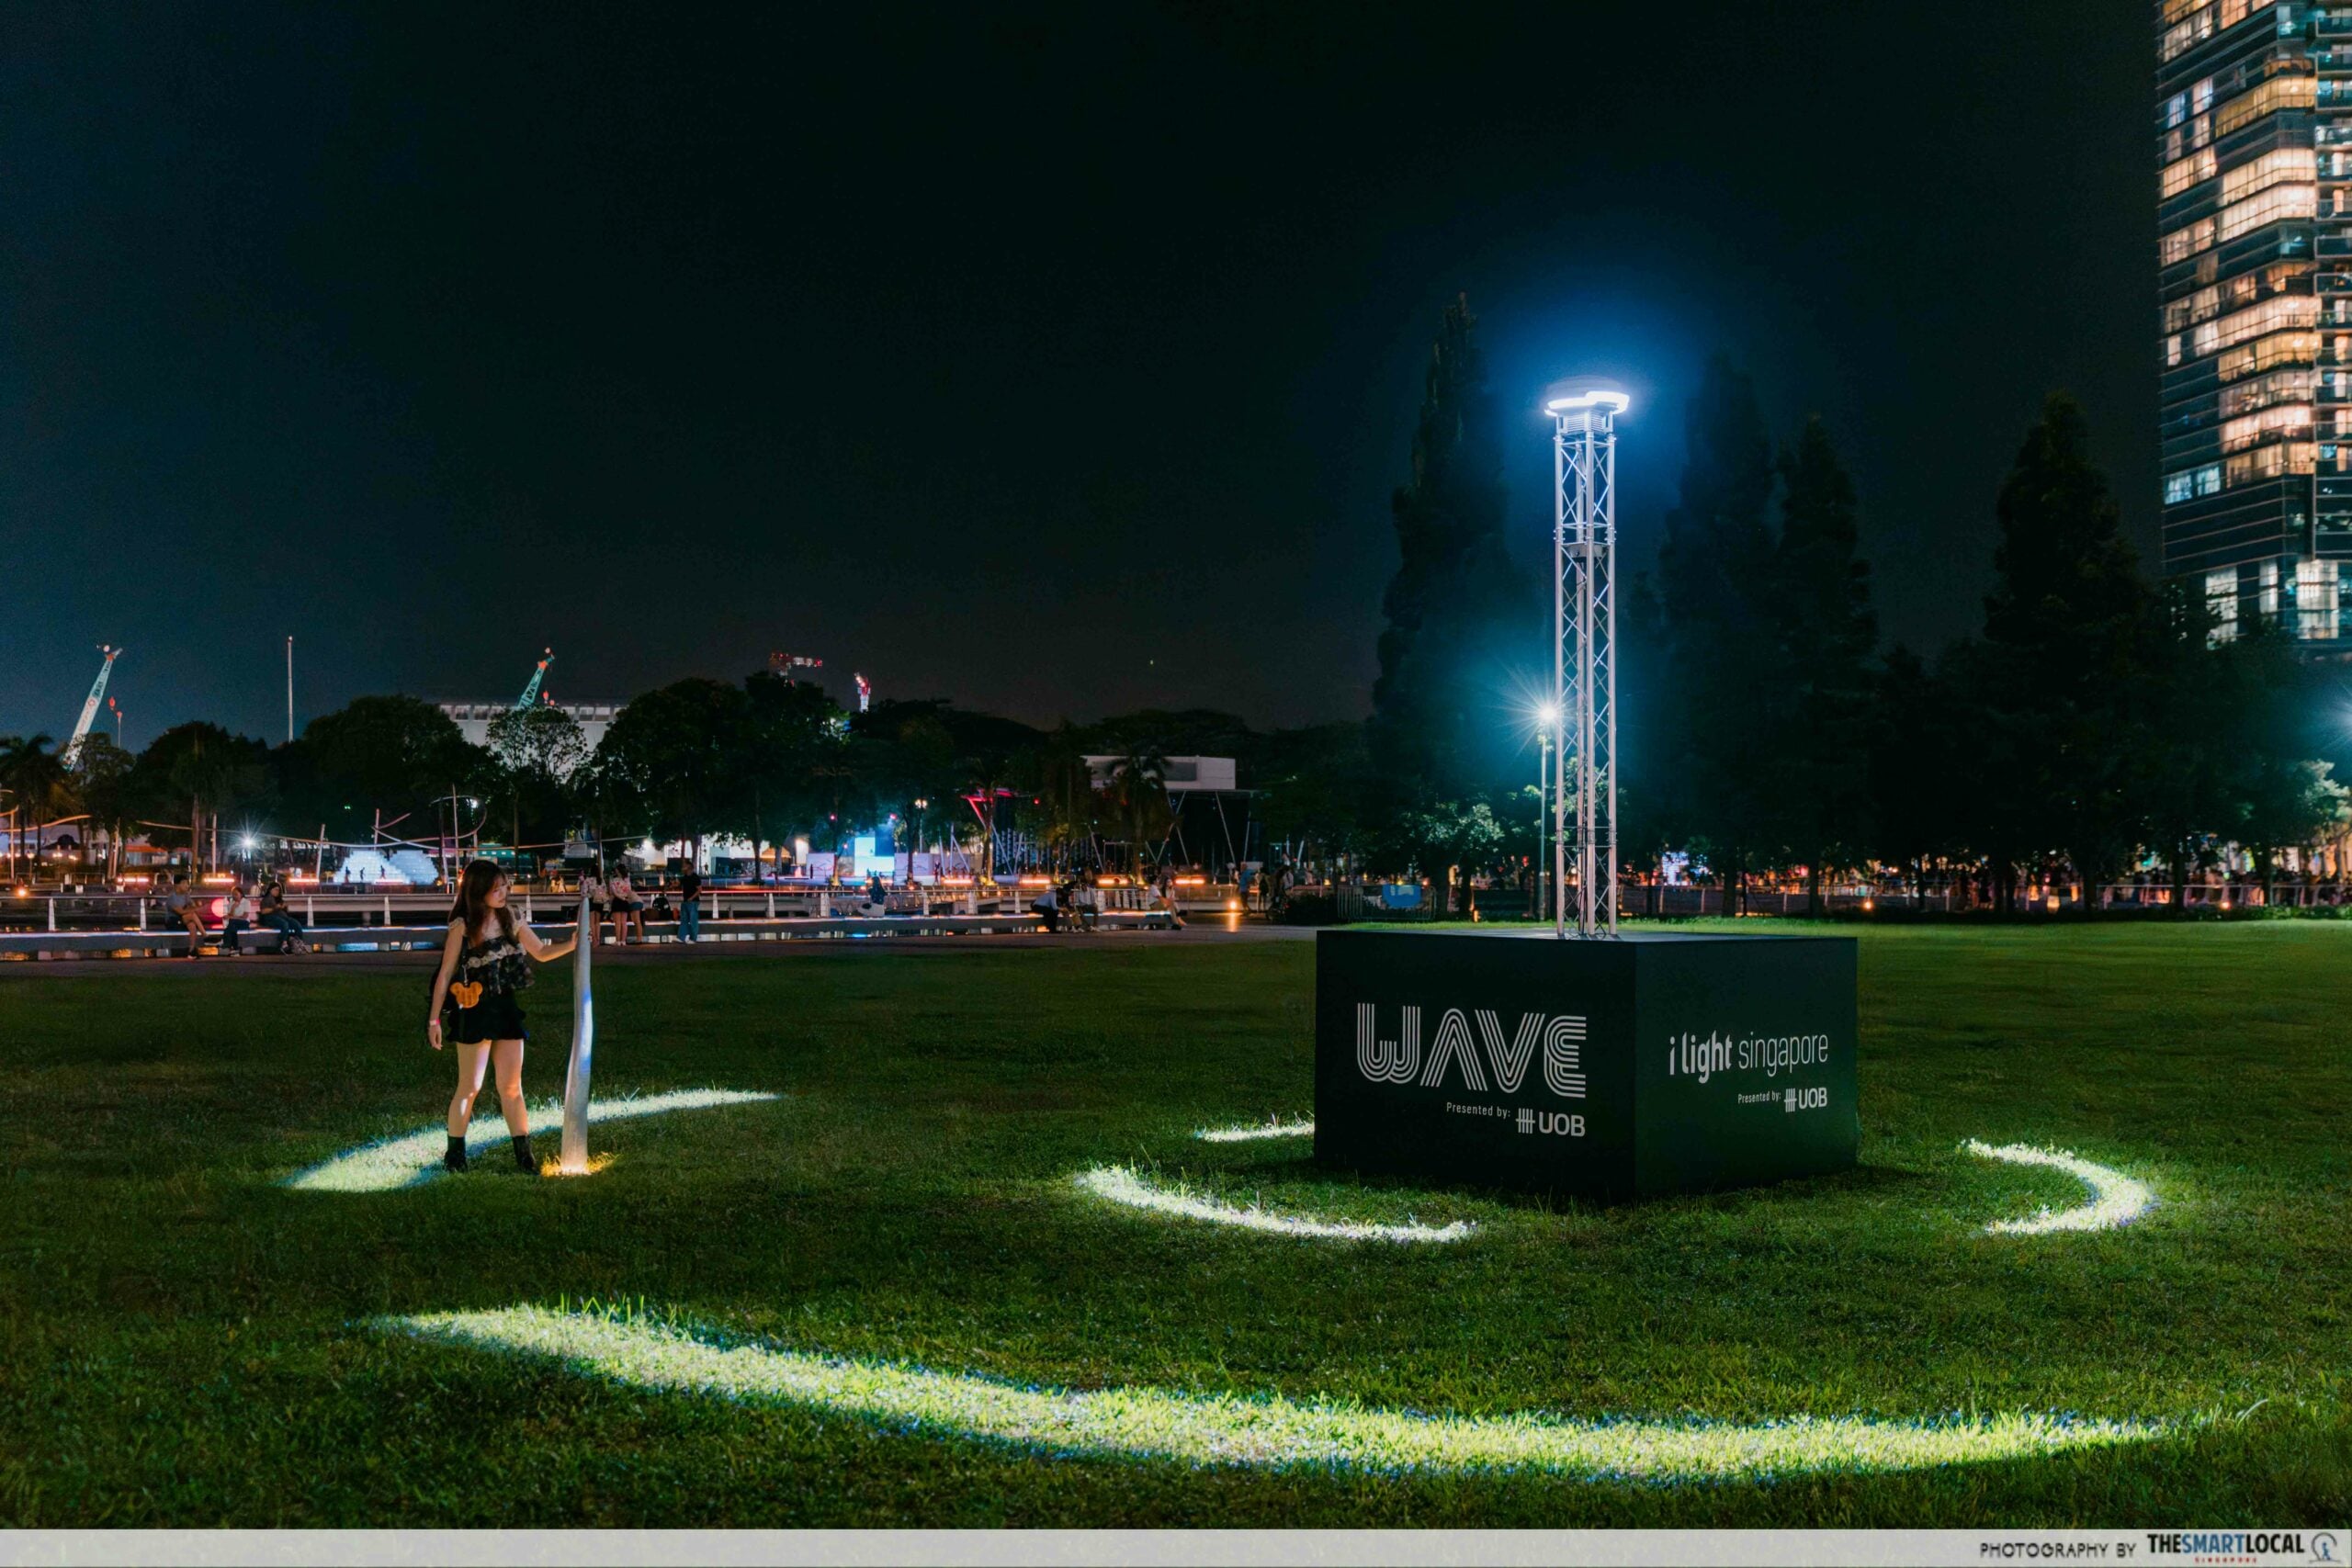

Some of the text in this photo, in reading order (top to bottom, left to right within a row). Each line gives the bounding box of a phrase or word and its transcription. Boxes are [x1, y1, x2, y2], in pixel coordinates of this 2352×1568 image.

[1356, 1002, 1587, 1099] WAVE
[1669, 1030, 1828, 1084] i light singapore
[1446, 1102, 1586, 1137] Presented by: UOB
[1737, 1087, 1828, 1110] Presented by: UOB
